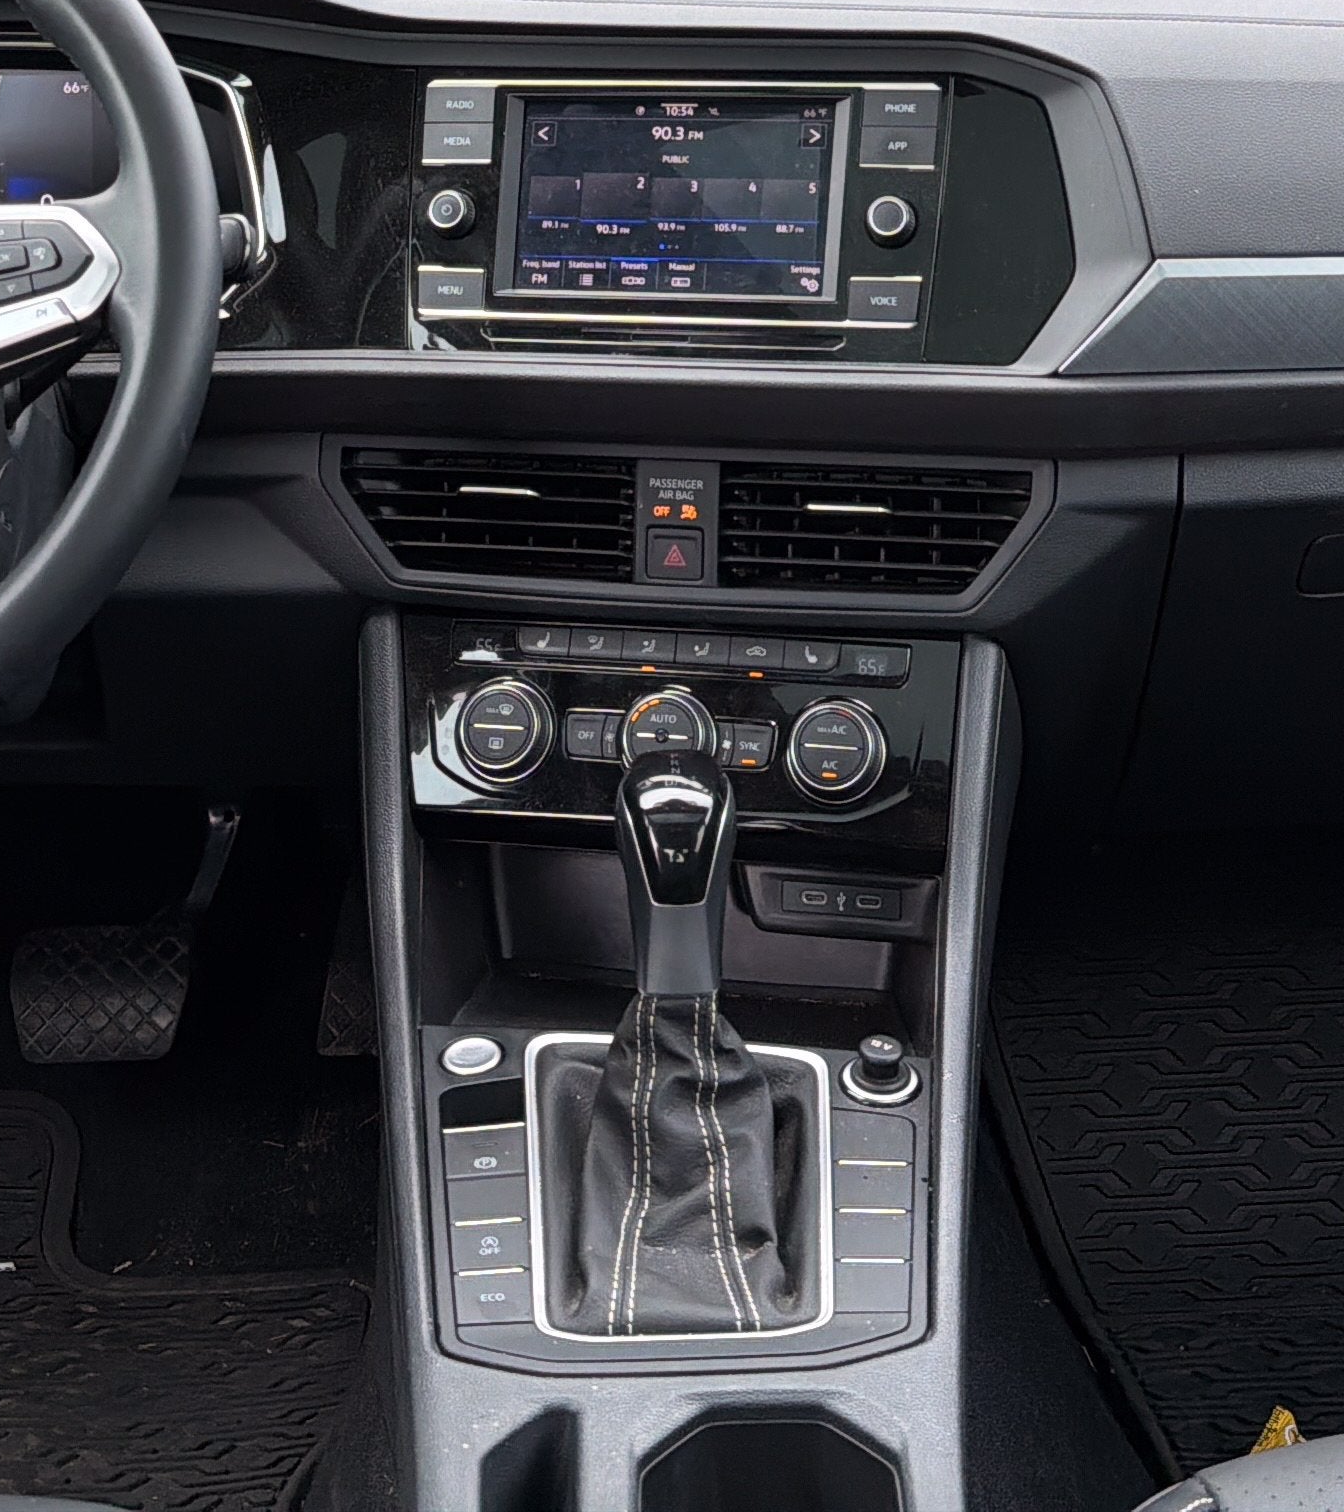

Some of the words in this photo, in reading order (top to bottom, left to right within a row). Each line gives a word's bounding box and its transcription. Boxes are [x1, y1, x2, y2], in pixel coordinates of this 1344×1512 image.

[445, 100, 475, 110] RADIO
[884, 103, 917, 113] PHONE
[665, 106, 694, 117] 10:54
[652, 126, 685, 141] 90.3
[688, 130, 704, 141] FM
[443, 136, 472, 146] MEDIA
[887, 141, 908, 151] APP
[661, 155, 690, 164] PUBLIC
[636, 177, 645, 189] 2
[690, 180, 698, 192] 3
[748, 182, 757, 193] 4
[808, 183, 817, 194] 5
[595, 224, 618, 235] 90.3
[620, 262, 648, 271] Presets
[668, 262, 695, 272] Manual
[790, 264, 821, 275] Settings
[531, 274, 548, 284] FM
[437, 286, 464, 295] MENU
[870, 296, 899, 306] VOICE
[649, 478, 704, 490] PASSENGER
[658, 490, 673, 499] AIR
[675, 490, 694, 500] BAG
[653, 506, 672, 517] OFF
[649, 714, 677, 724] AUTO
[578, 730, 596, 740] OFF
[739, 742, 760, 751] SYNC
[821, 760, 838, 770] A/C
[478, 1247, 501, 1256] OFF
[480, 1292, 505, 1302] ECO
